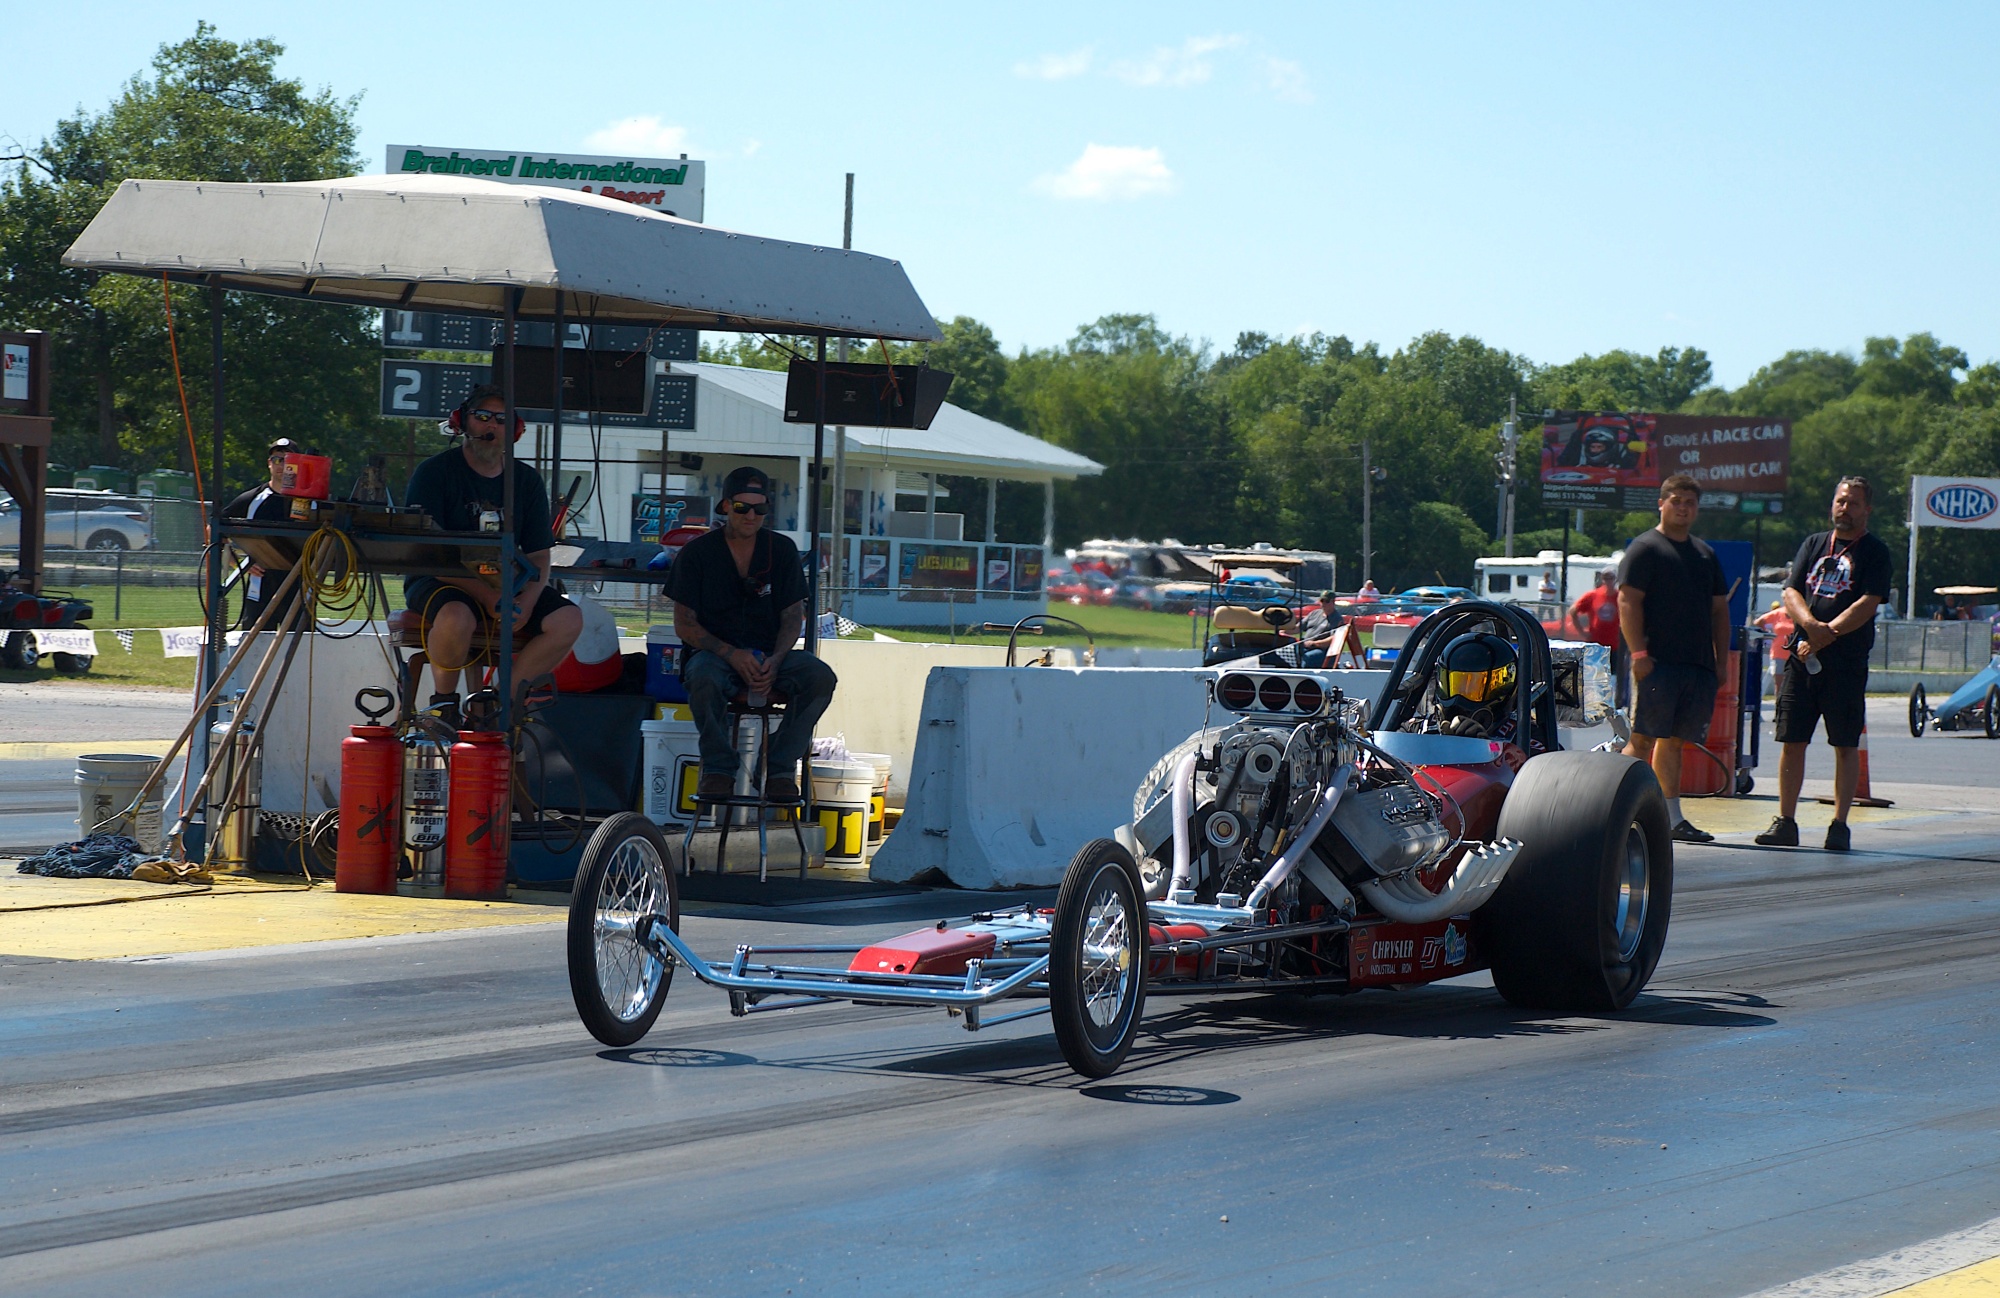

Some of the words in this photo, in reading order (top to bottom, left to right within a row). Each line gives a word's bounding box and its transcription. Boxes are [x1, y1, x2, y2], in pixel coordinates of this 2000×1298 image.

[401, 150, 517, 176] Brainerd
[518, 156, 689, 185] International
[392, 368, 422, 411] 2
[1663, 433, 1700, 447] DRIVE
[1701, 432, 1711, 446] A
[1713, 427, 1751, 444] RACE
[1753, 424, 1785, 441] CAR
[1679, 450, 1700, 464] OR
[1710, 464, 1746, 480] OWN
[1935, 490, 1990, 516] NHRA
[40, 632, 90, 647] Hoosier
[410, 816, 443, 825] PROPERTY
[423, 825, 432, 833] OF
[1372, 940, 1414, 960] CHRYSLER
[1370, 964, 1396, 975] INDUSTRIAL
[1401, 963, 1412, 973] IRON
